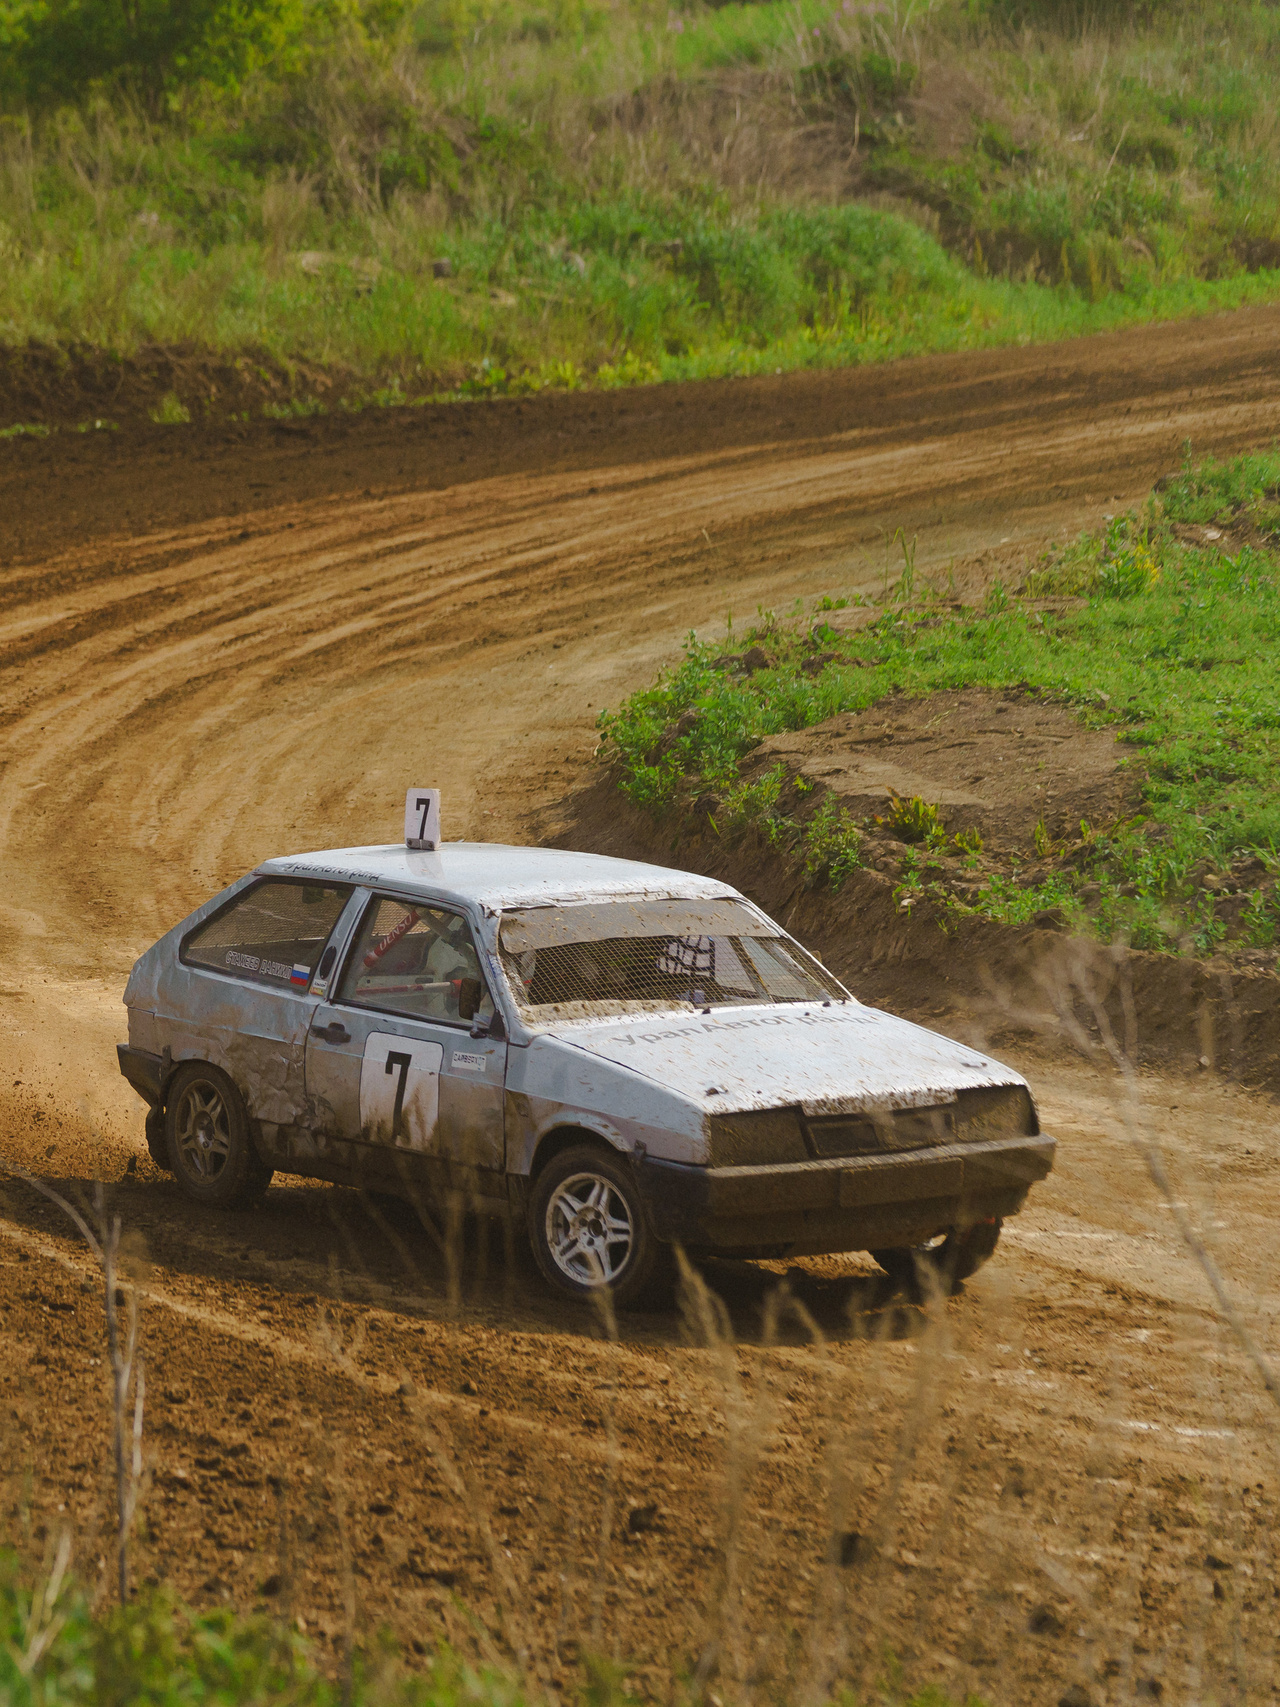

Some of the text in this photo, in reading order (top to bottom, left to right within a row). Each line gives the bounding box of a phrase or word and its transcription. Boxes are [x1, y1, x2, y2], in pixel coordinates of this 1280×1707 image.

[416, 798, 430, 840] 7
[226, 950, 260, 971] СТАХЕЕВ
[385, 1050, 412, 1140] 7
